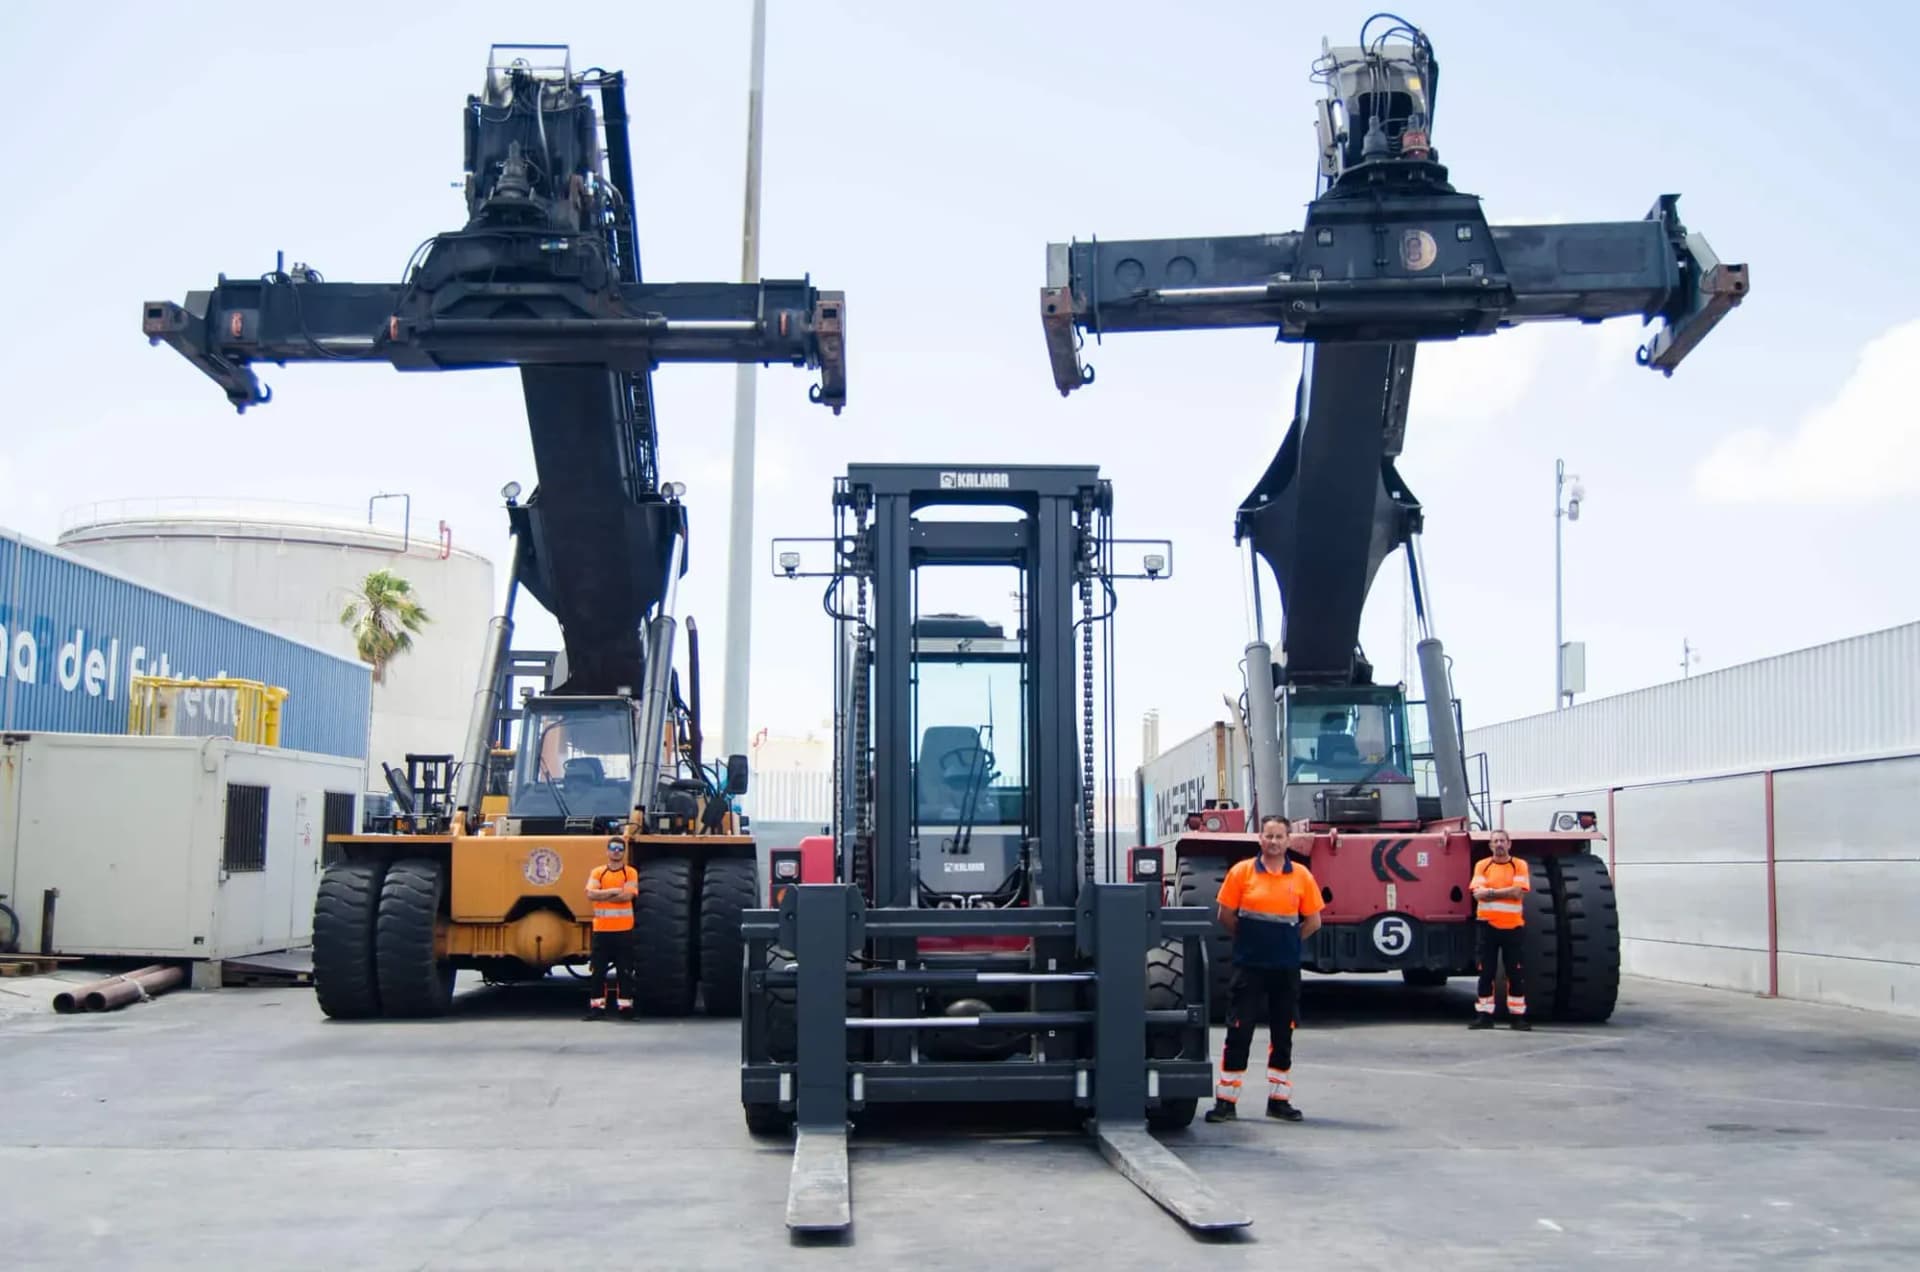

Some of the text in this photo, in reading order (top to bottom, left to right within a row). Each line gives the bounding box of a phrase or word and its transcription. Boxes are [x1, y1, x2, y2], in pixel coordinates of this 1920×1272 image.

[958, 473, 1009, 488] KALMAR
[58, 629, 118, 701] del
[1381, 921, 1404, 951] 5
